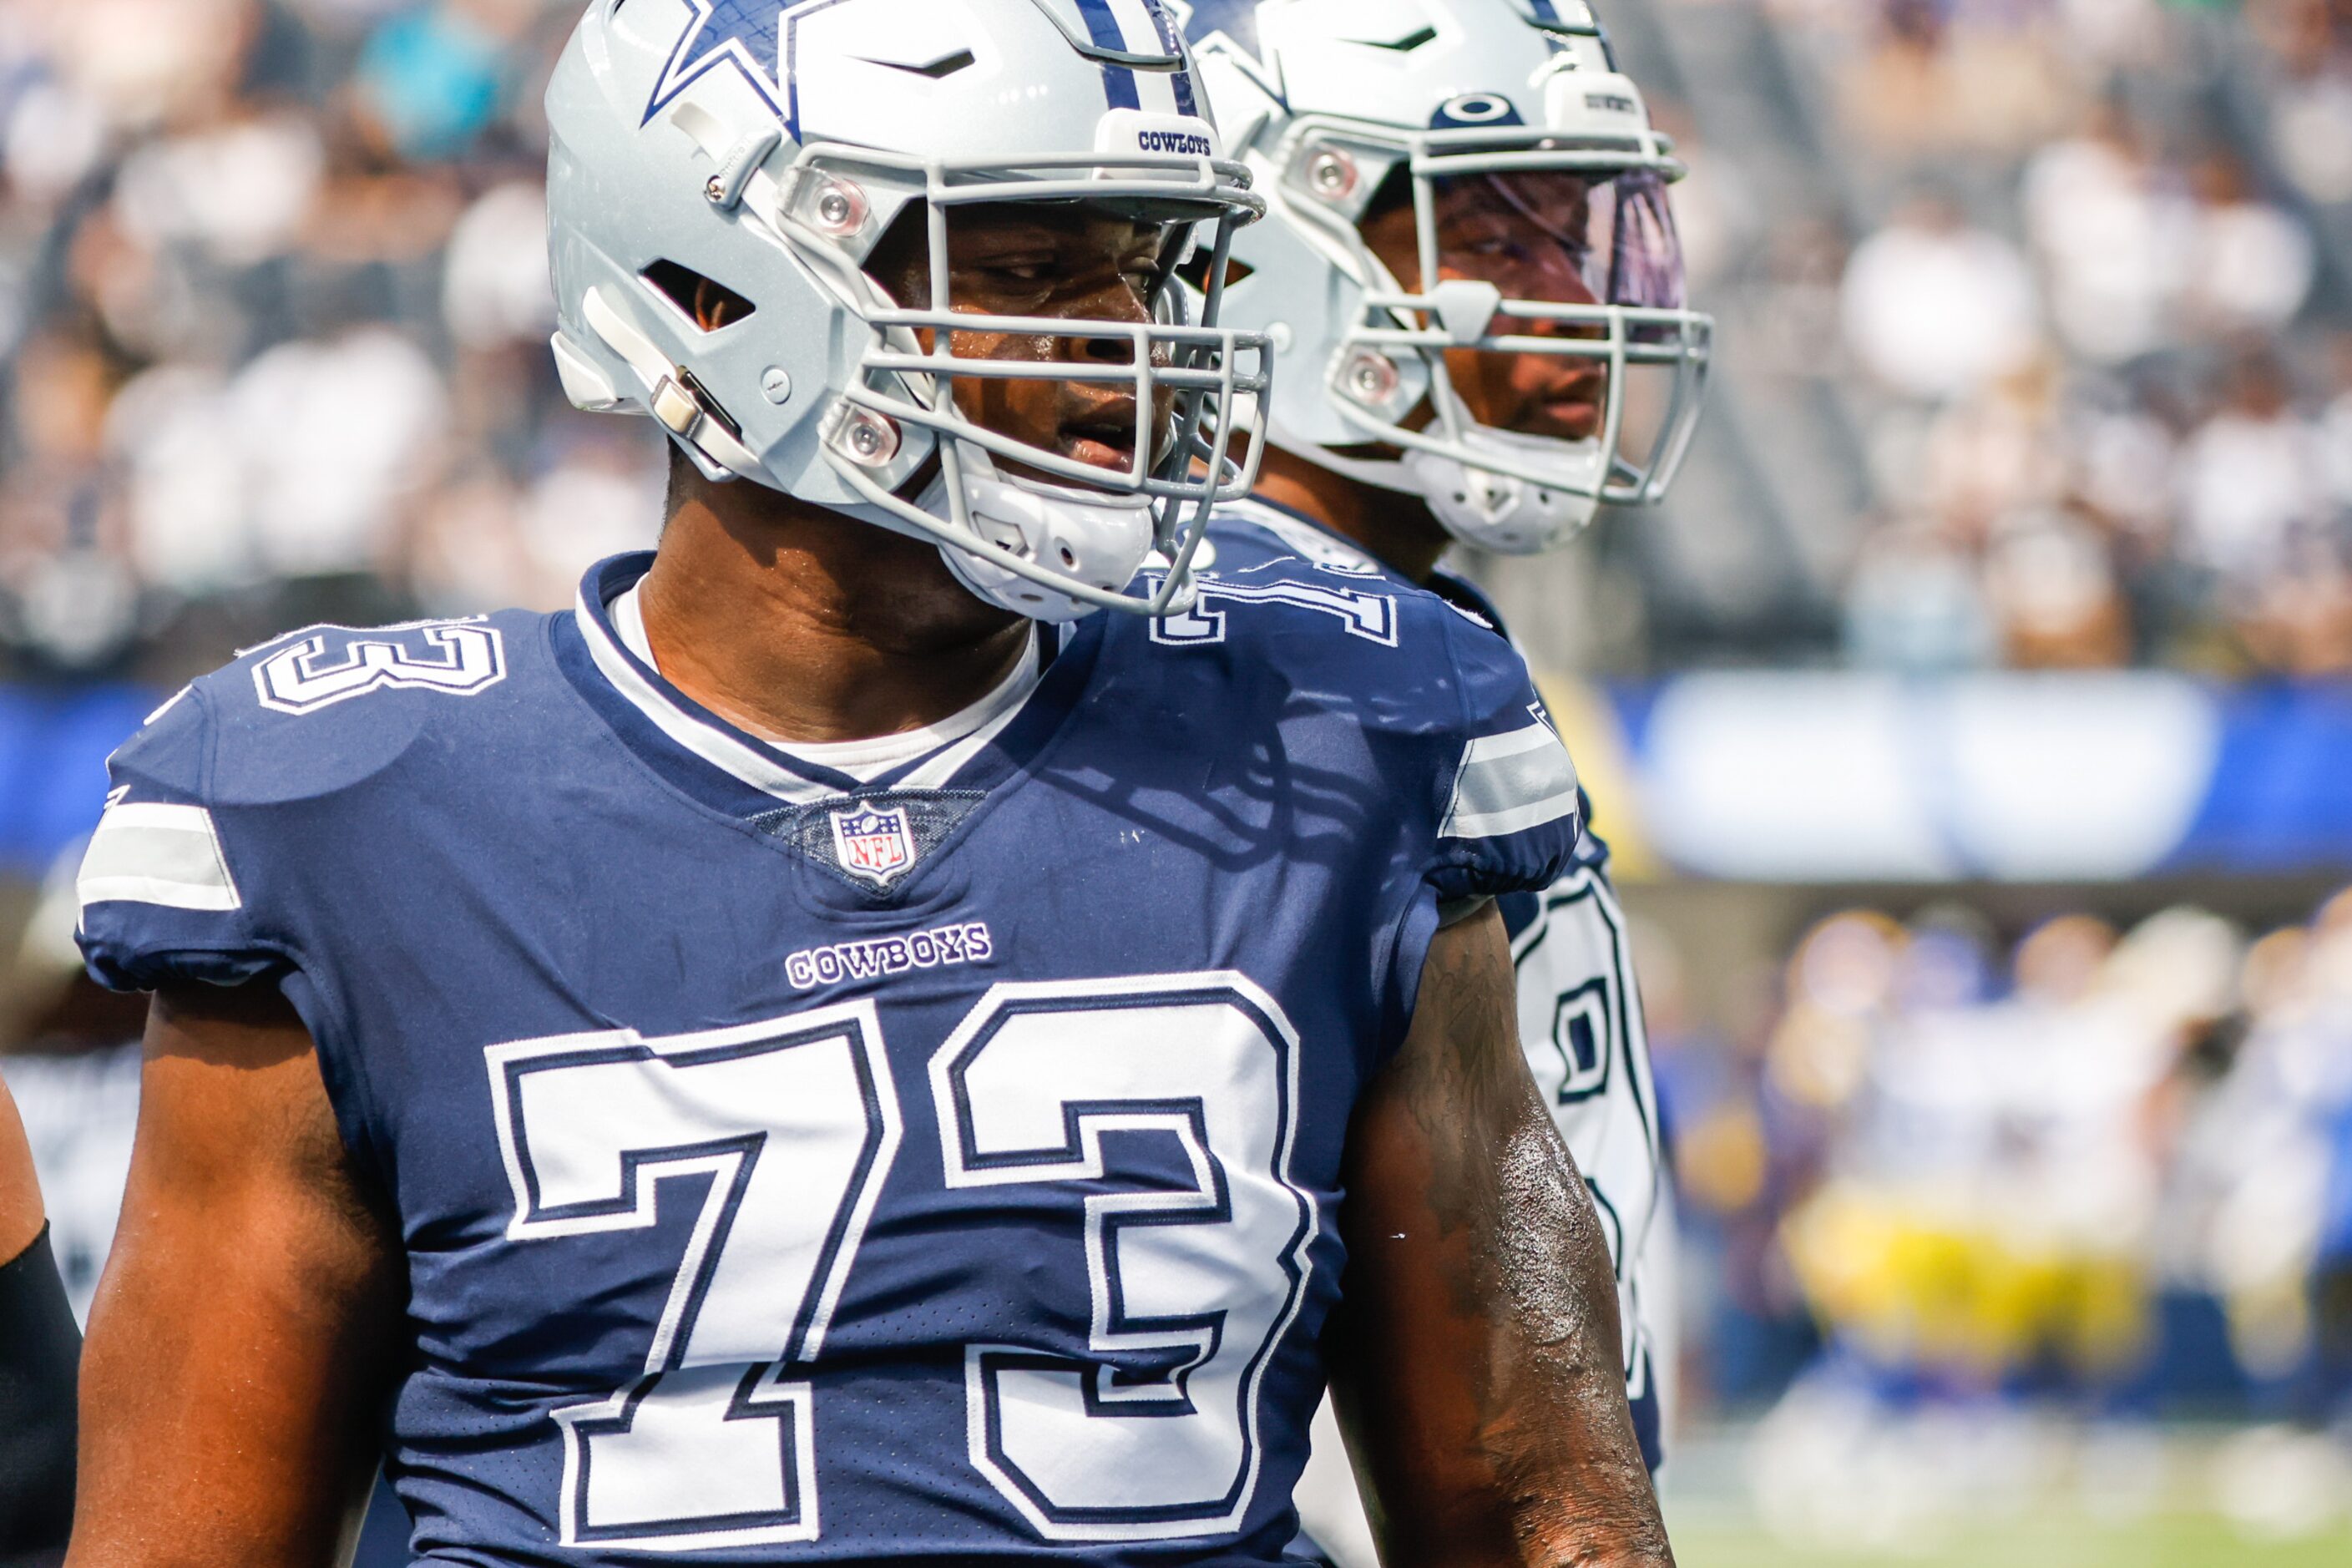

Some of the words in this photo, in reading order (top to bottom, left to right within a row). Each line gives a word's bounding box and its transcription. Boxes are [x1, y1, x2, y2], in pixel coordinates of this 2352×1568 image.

[1138, 130, 1211, 156] COWBOYS
[1144, 554, 1399, 648] 7
[233, 614, 507, 716] 3
[848, 835, 903, 868] NFL
[785, 923, 992, 989] COWBOYS
[483, 969, 1319, 1550] 73
